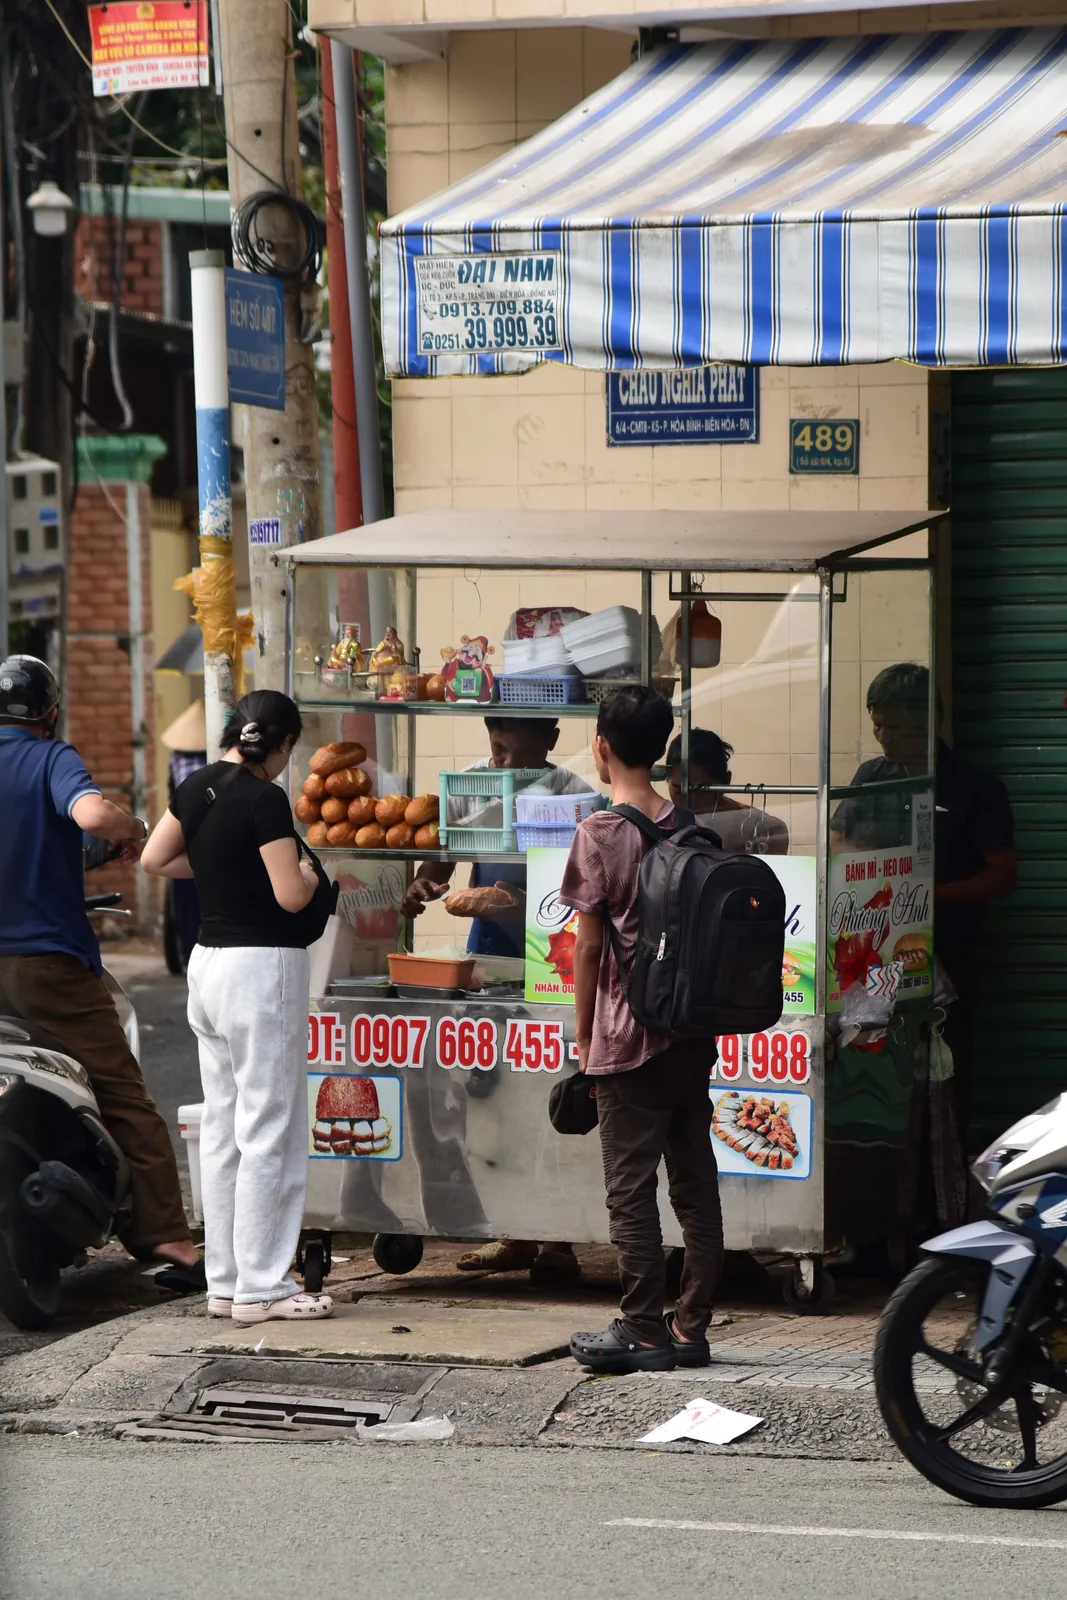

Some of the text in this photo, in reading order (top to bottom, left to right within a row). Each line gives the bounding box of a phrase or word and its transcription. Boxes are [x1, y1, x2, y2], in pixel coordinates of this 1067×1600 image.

[458, 258, 554, 288] ĐẠI NAM
[439, 300, 555, 318] 0913.709.884
[671, 416, 685, 432] HÒA
[705, 416, 719, 432] BIÊN
[721, 415, 736, 431] HÒA
[794, 424, 853, 452] 489
[845, 860, 866, 882] BÁNH
[867, 856, 877, 879] MÌ
[883, 858, 898, 877] HEO
[892, 881, 930, 926] Anh
[535, 982, 559, 995] NHẬN
[785, 992, 804, 1003] 455
[354, 1017, 427, 1065] 0907
[439, 1021, 494, 1067] 668
[506, 1023, 560, 1069] 455
[752, 1032, 807, 1080] 988
